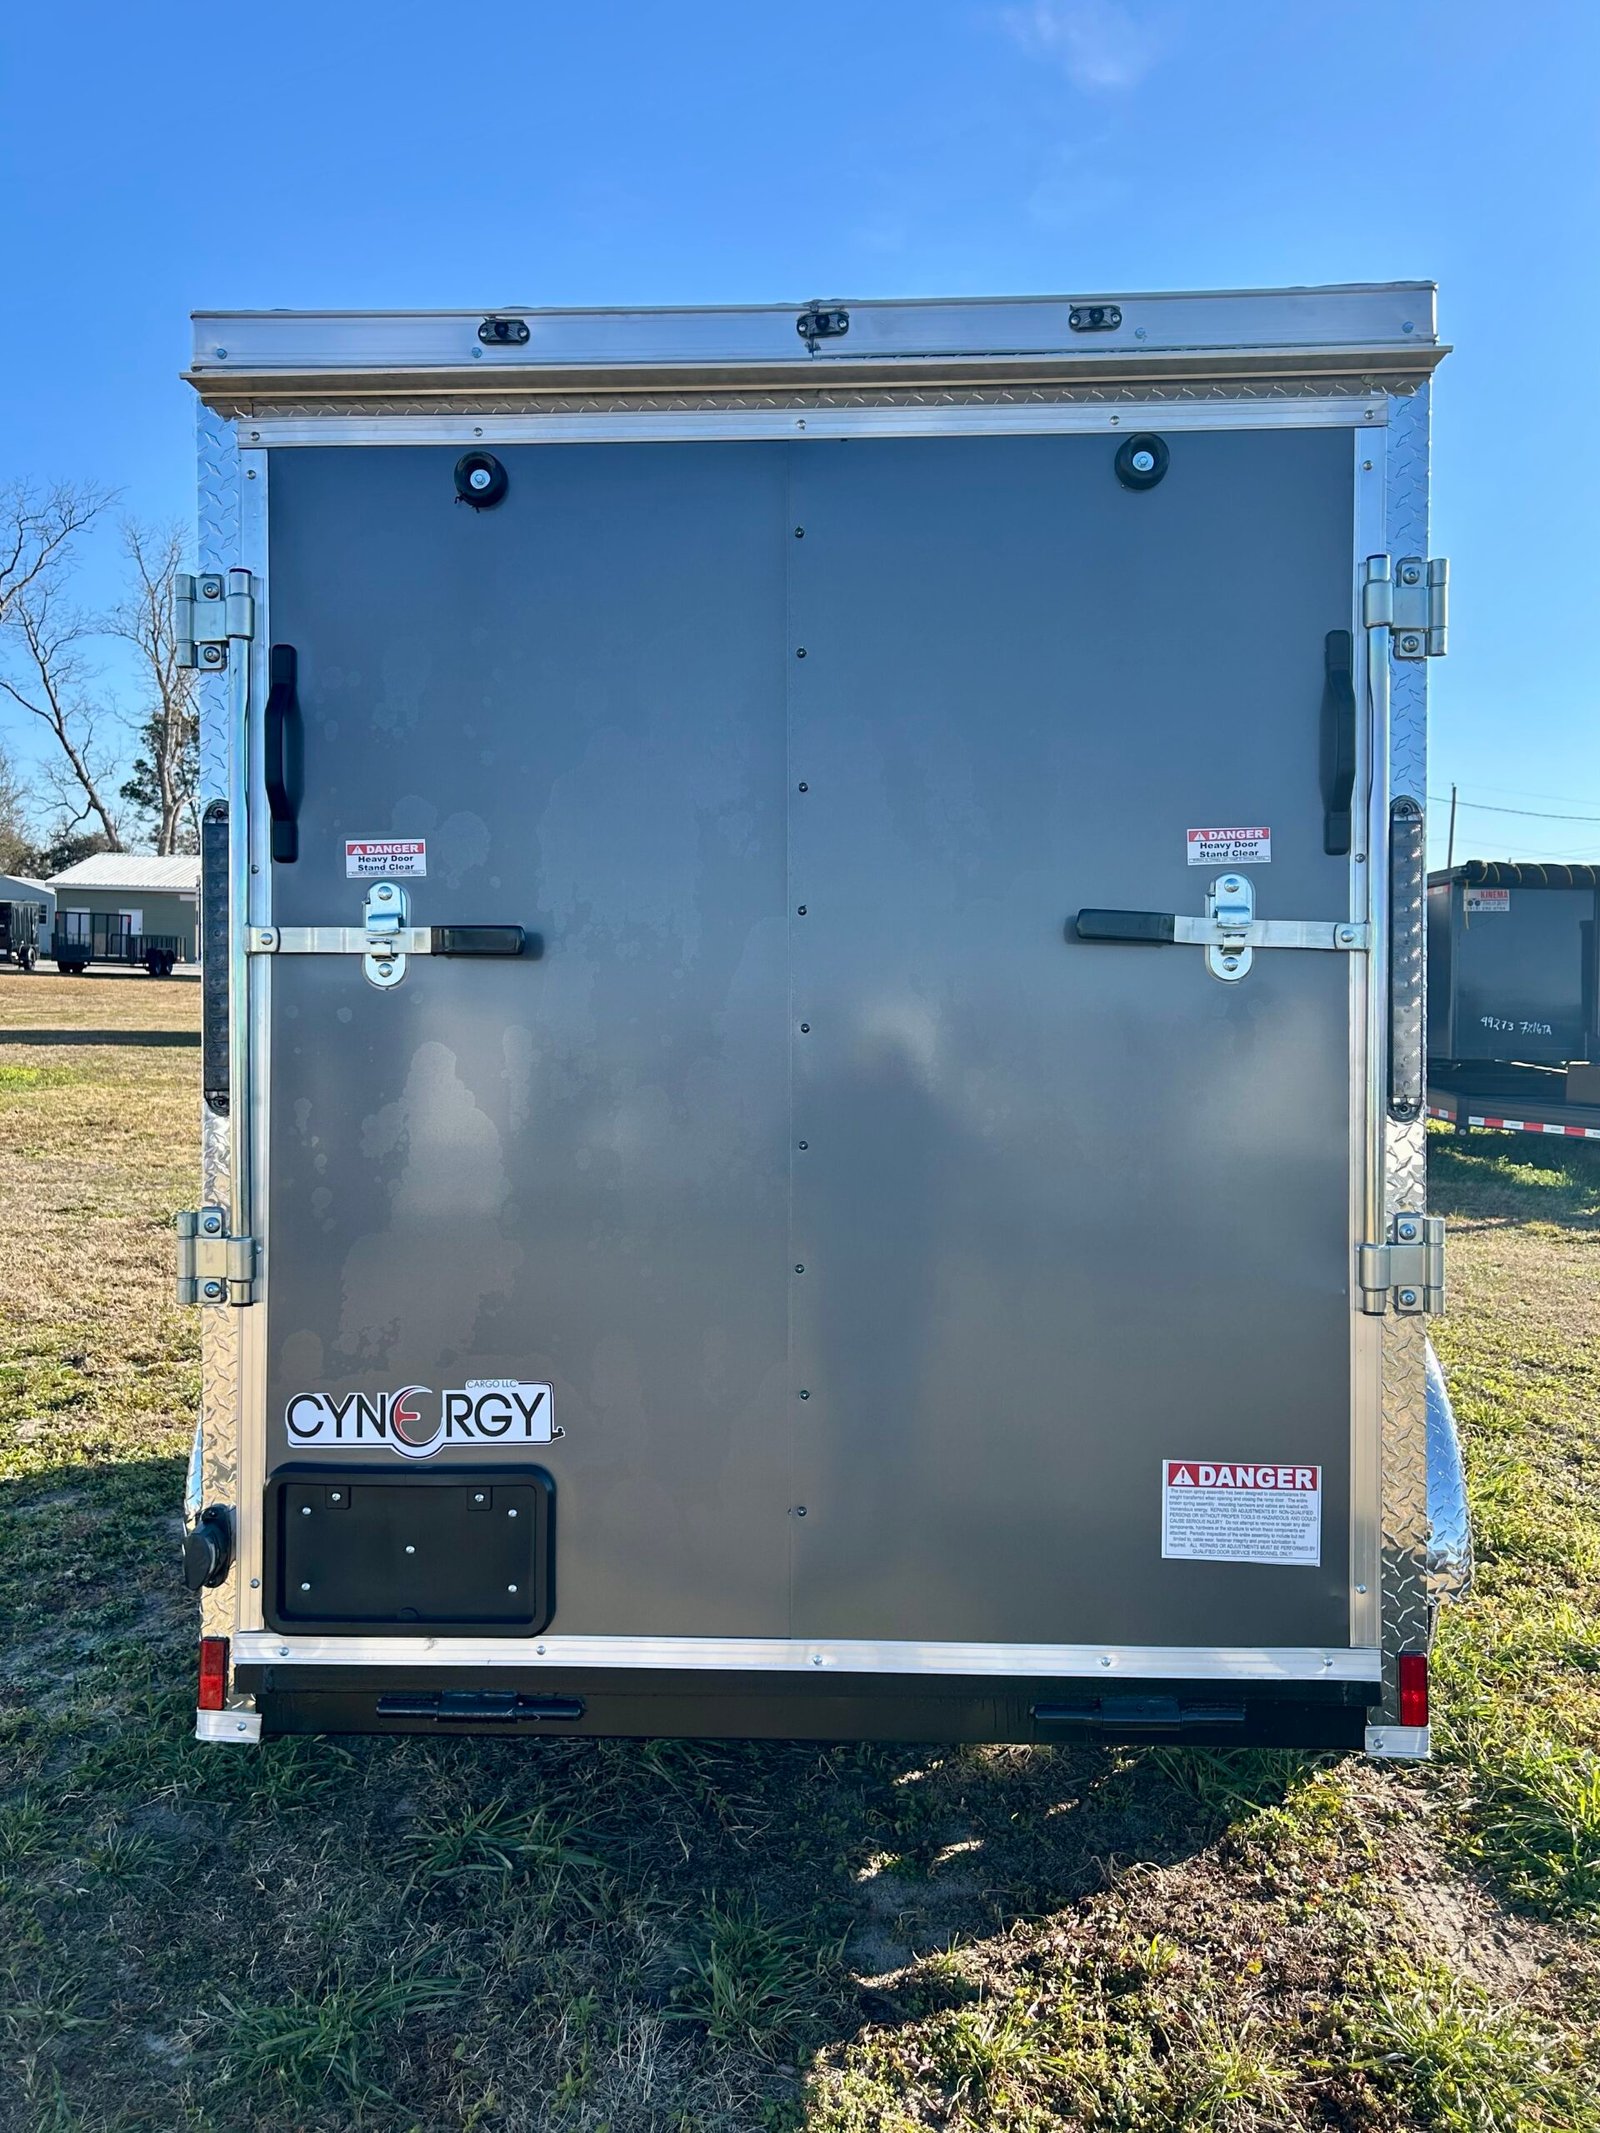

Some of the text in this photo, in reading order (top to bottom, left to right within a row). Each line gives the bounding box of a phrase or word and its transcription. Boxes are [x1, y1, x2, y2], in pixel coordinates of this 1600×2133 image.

[1208, 829, 1264, 840] DANGER
[366, 844, 419, 854] DANGER
[1200, 850, 1229, 858] Stand
[466, 1379, 518, 1389] CARGO LLC
[286, 1385, 546, 1447] CYNERGY
[1199, 1466, 1313, 1489] DANGER
